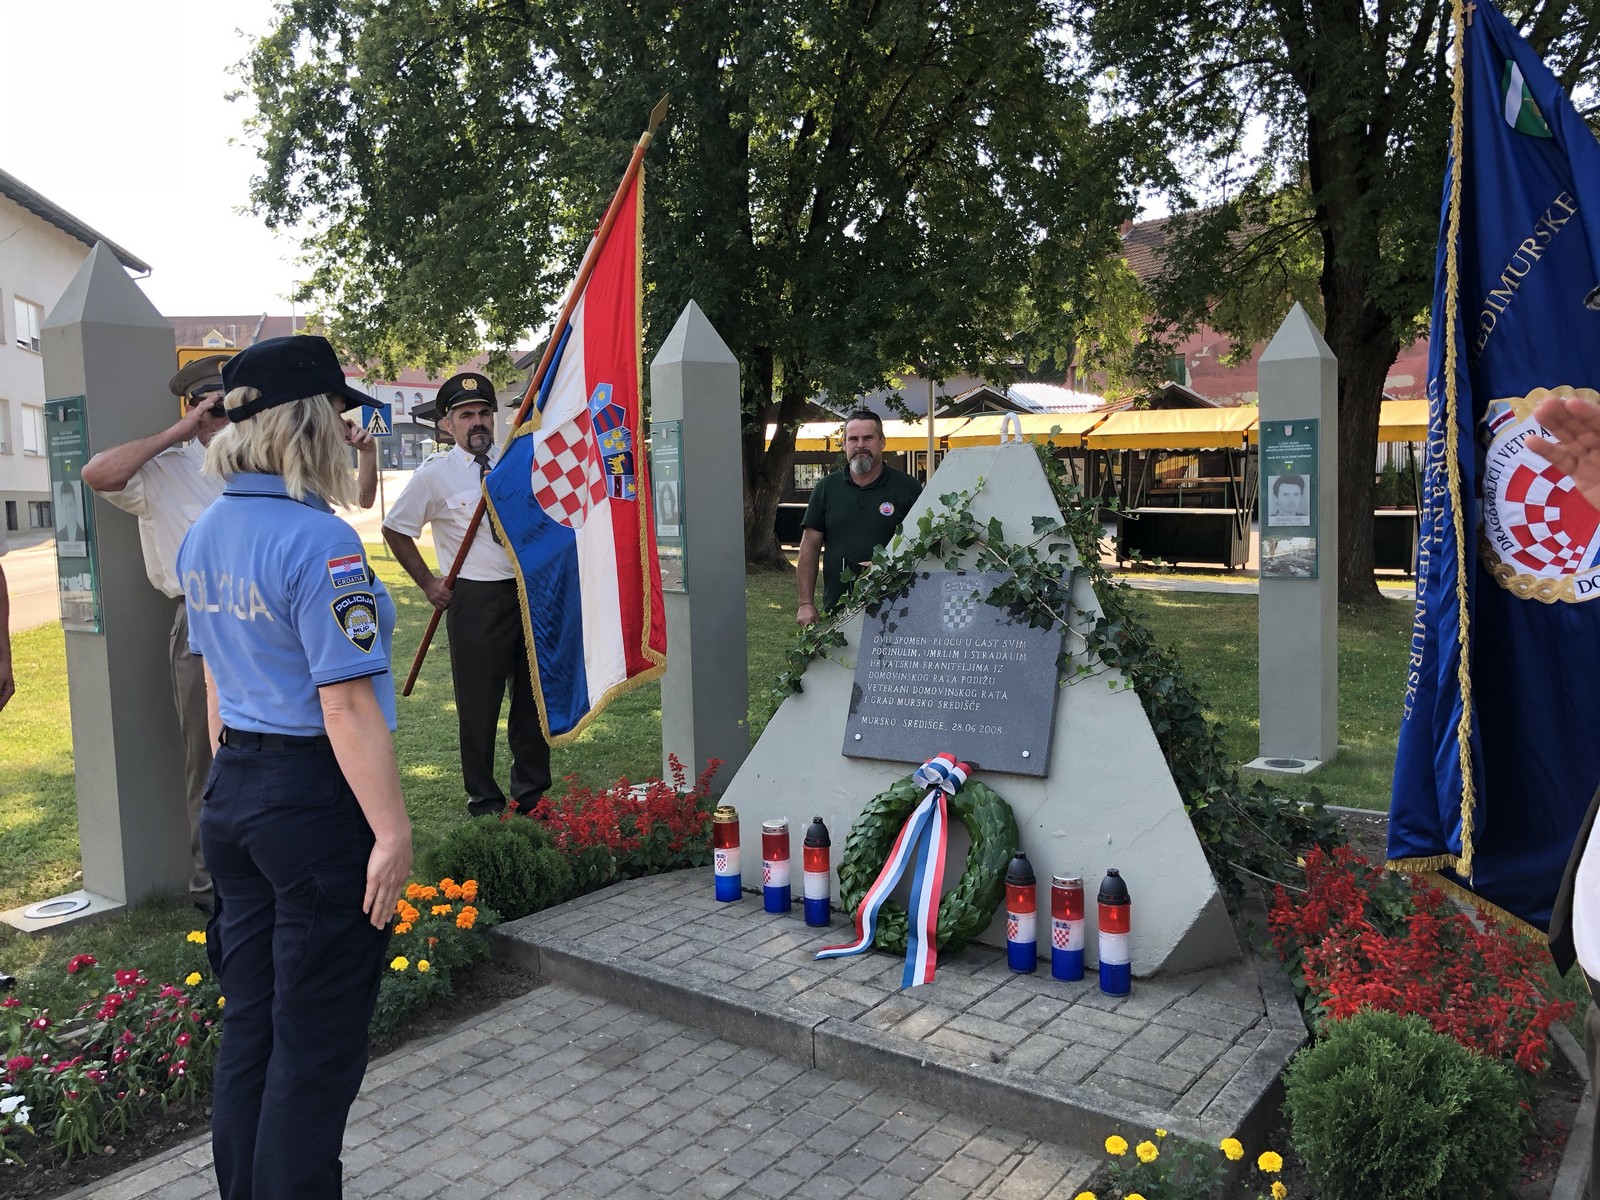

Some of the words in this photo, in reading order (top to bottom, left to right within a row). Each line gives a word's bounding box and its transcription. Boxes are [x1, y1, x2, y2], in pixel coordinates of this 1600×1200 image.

[1487, 466, 1514, 551] DRAGOVOLJCI
[337, 574, 364, 586] CROATIA
[335, 595, 374, 612] POLICIJA
[353, 625, 370, 634] MUP
[894, 636, 927, 645] SPOMEN
[965, 639, 971, 647] U
[1002, 640, 1027, 649] SVIM
[923, 649, 959, 659] UMRLIM
[970, 650, 1027, 661] STRADALIM
[870, 659, 919, 669] HRVATSKIM
[922, 661, 989, 672] BRANITELJIMA
[993, 664, 1004, 673] IZ
[868, 671, 929, 681] DOMOVINSKOG
[932, 674, 958, 683] RATA
[961, 675, 996, 685] PODIŽU
[867, 683, 910, 694] VETERANI
[912, 686, 977, 697] DOMOVINSKOG
[981, 690, 1008, 700] RATA
[870, 696, 894, 705] GRAD
[896, 698, 934, 708] MURSKO
[861, 716, 897, 726] MURSKO
